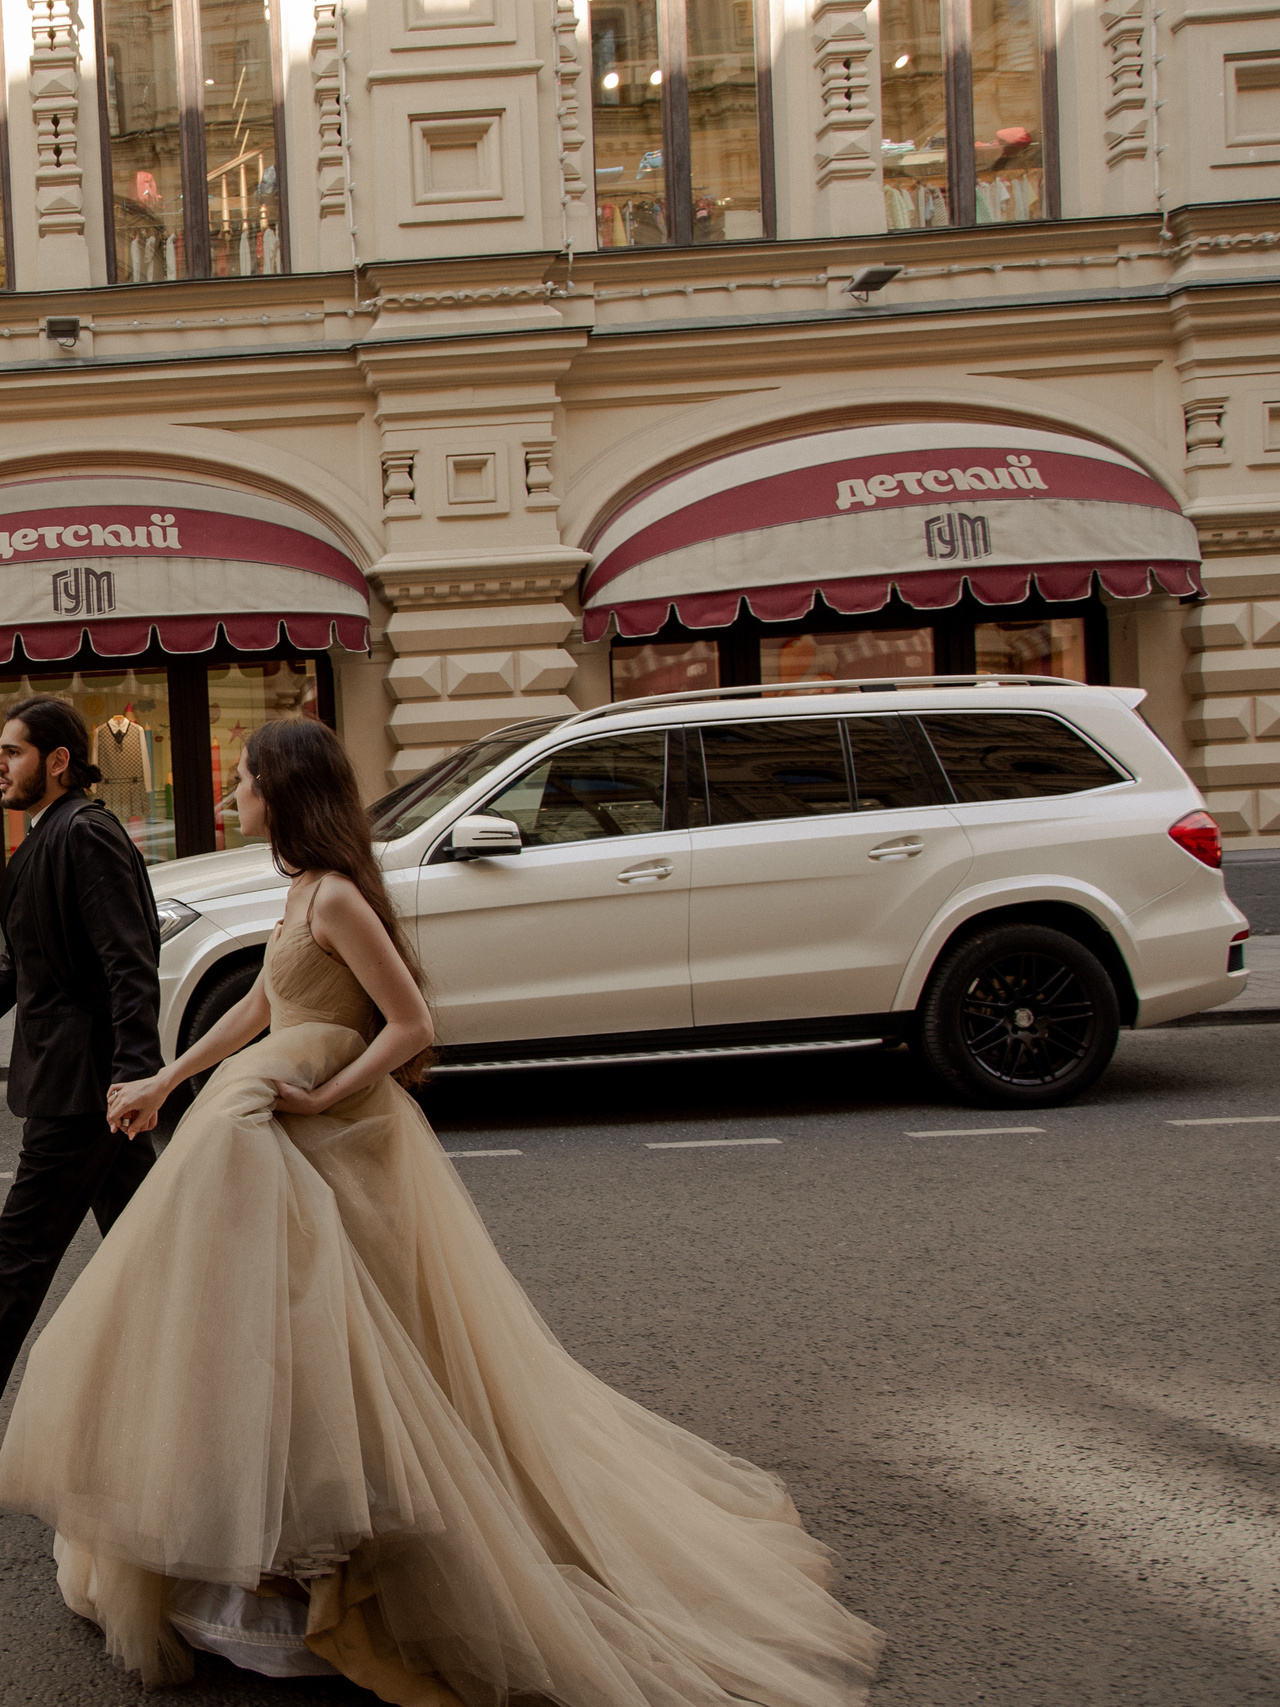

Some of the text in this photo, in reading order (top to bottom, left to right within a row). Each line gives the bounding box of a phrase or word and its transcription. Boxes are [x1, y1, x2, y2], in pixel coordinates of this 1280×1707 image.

[836, 455, 1048, 510] детский
[925, 512, 993, 561] ГУМ
[52, 567, 116, 616] ГУМ
